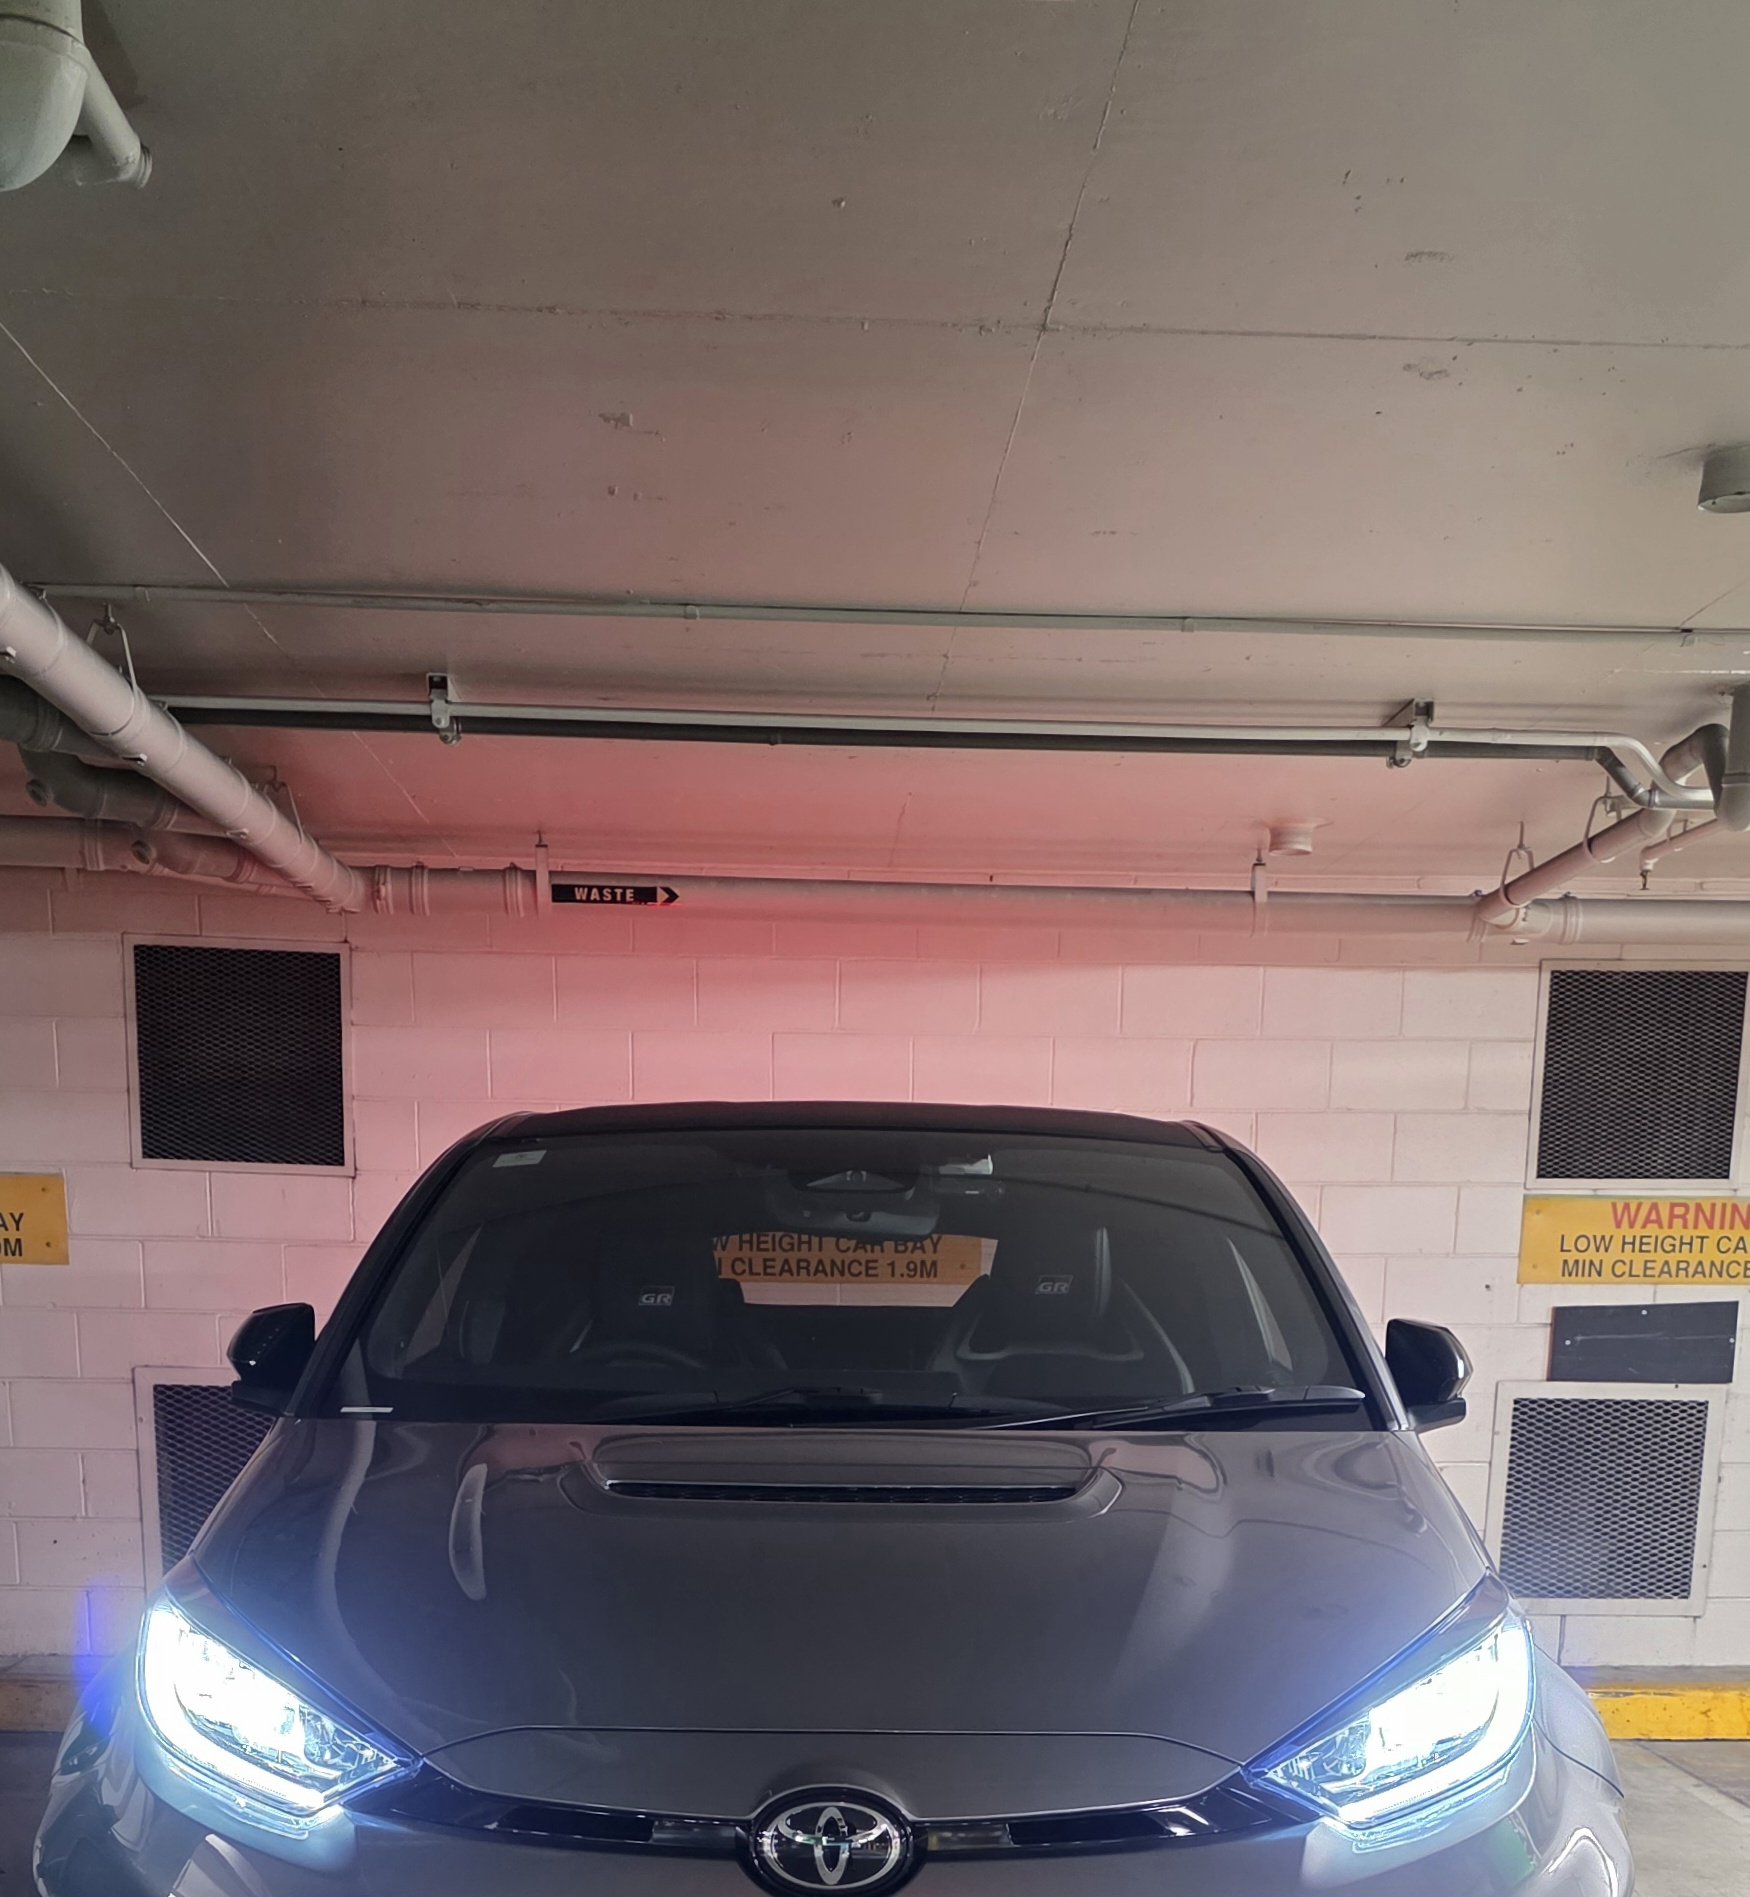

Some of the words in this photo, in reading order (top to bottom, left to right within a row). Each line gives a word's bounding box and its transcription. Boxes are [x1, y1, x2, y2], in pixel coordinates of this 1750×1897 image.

[574, 887, 635, 901] WASTE
[739, 1232, 824, 1253] HEIGHT
[1559, 1234, 1614, 1253] LOW
[1621, 1235, 1709, 1254] HEIGHT
[730, 1257, 879, 1278] CLEARANCE
[887, 1260, 938, 1278] 1.9M
[1561, 1259, 1603, 1277] MIN
[642, 1293, 672, 1304] GR
